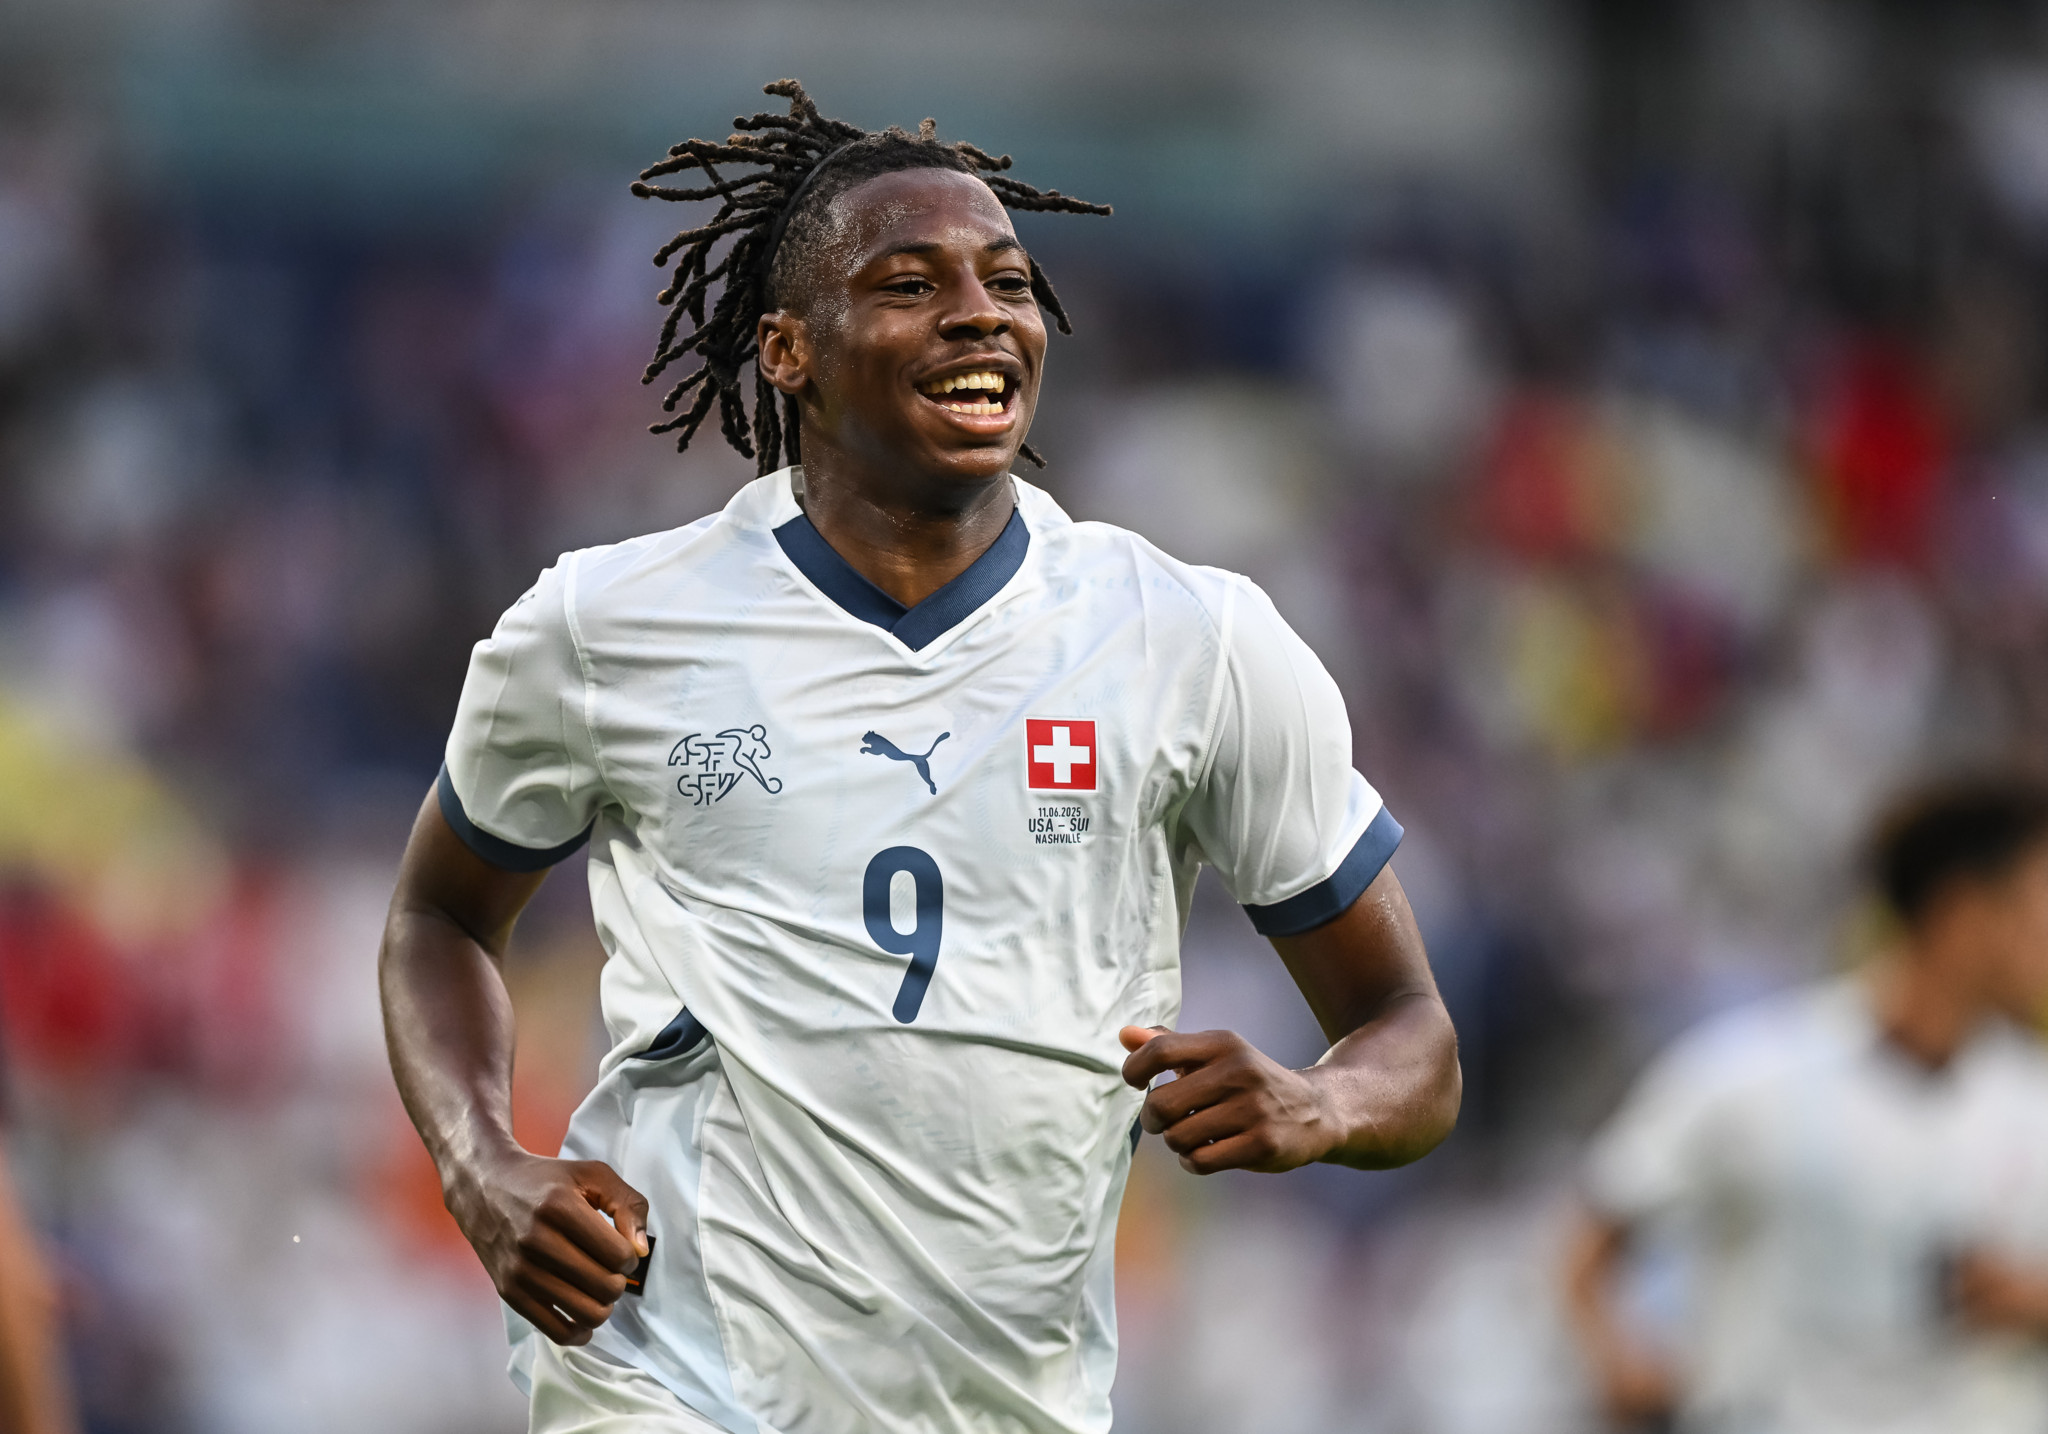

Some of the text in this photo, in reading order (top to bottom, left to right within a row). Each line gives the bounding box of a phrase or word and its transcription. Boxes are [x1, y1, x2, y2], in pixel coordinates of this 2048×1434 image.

[667, 733, 726, 772] ASF
[1038, 807, 1081, 817] 11.06.2025
[1028, 818, 1053, 832] USA
[1069, 818, 1089, 832] SUI
[1035, 833, 1081, 844] NASHVILLE
[863, 845, 944, 1025] 9
